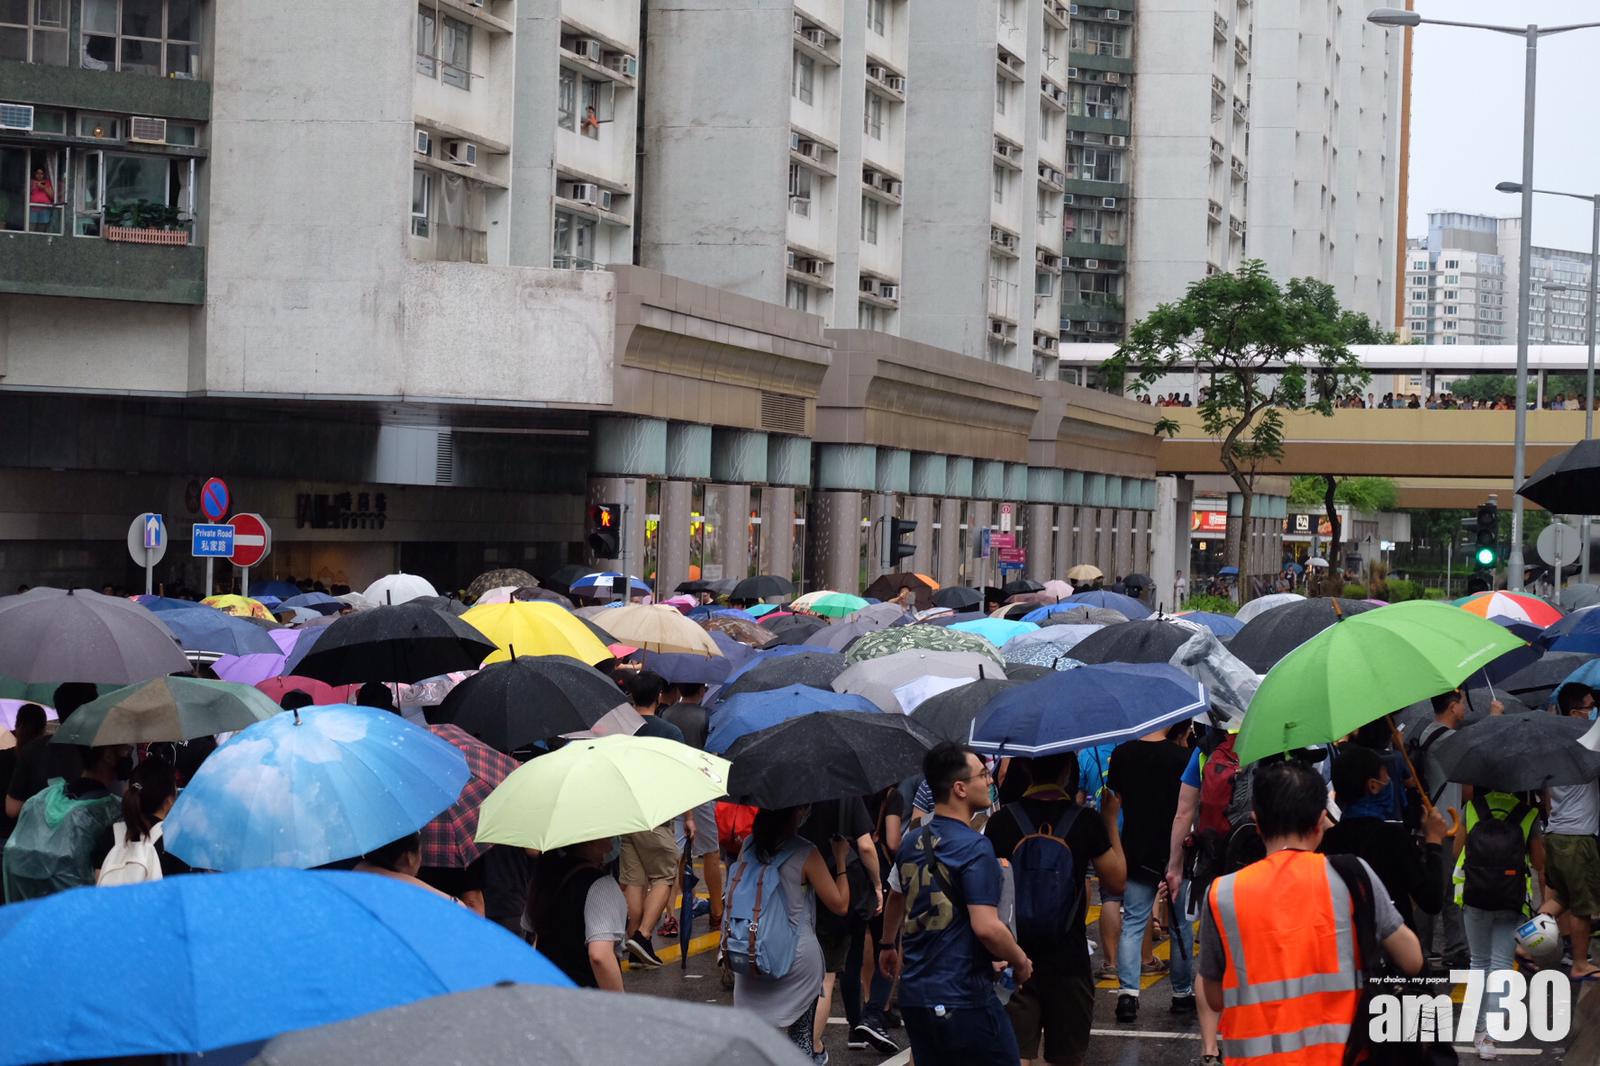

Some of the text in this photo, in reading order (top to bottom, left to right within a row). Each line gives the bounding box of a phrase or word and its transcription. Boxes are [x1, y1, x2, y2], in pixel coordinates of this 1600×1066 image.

[195, 529, 232, 538] Private Road
[201, 540, 226, 552] 私家路
